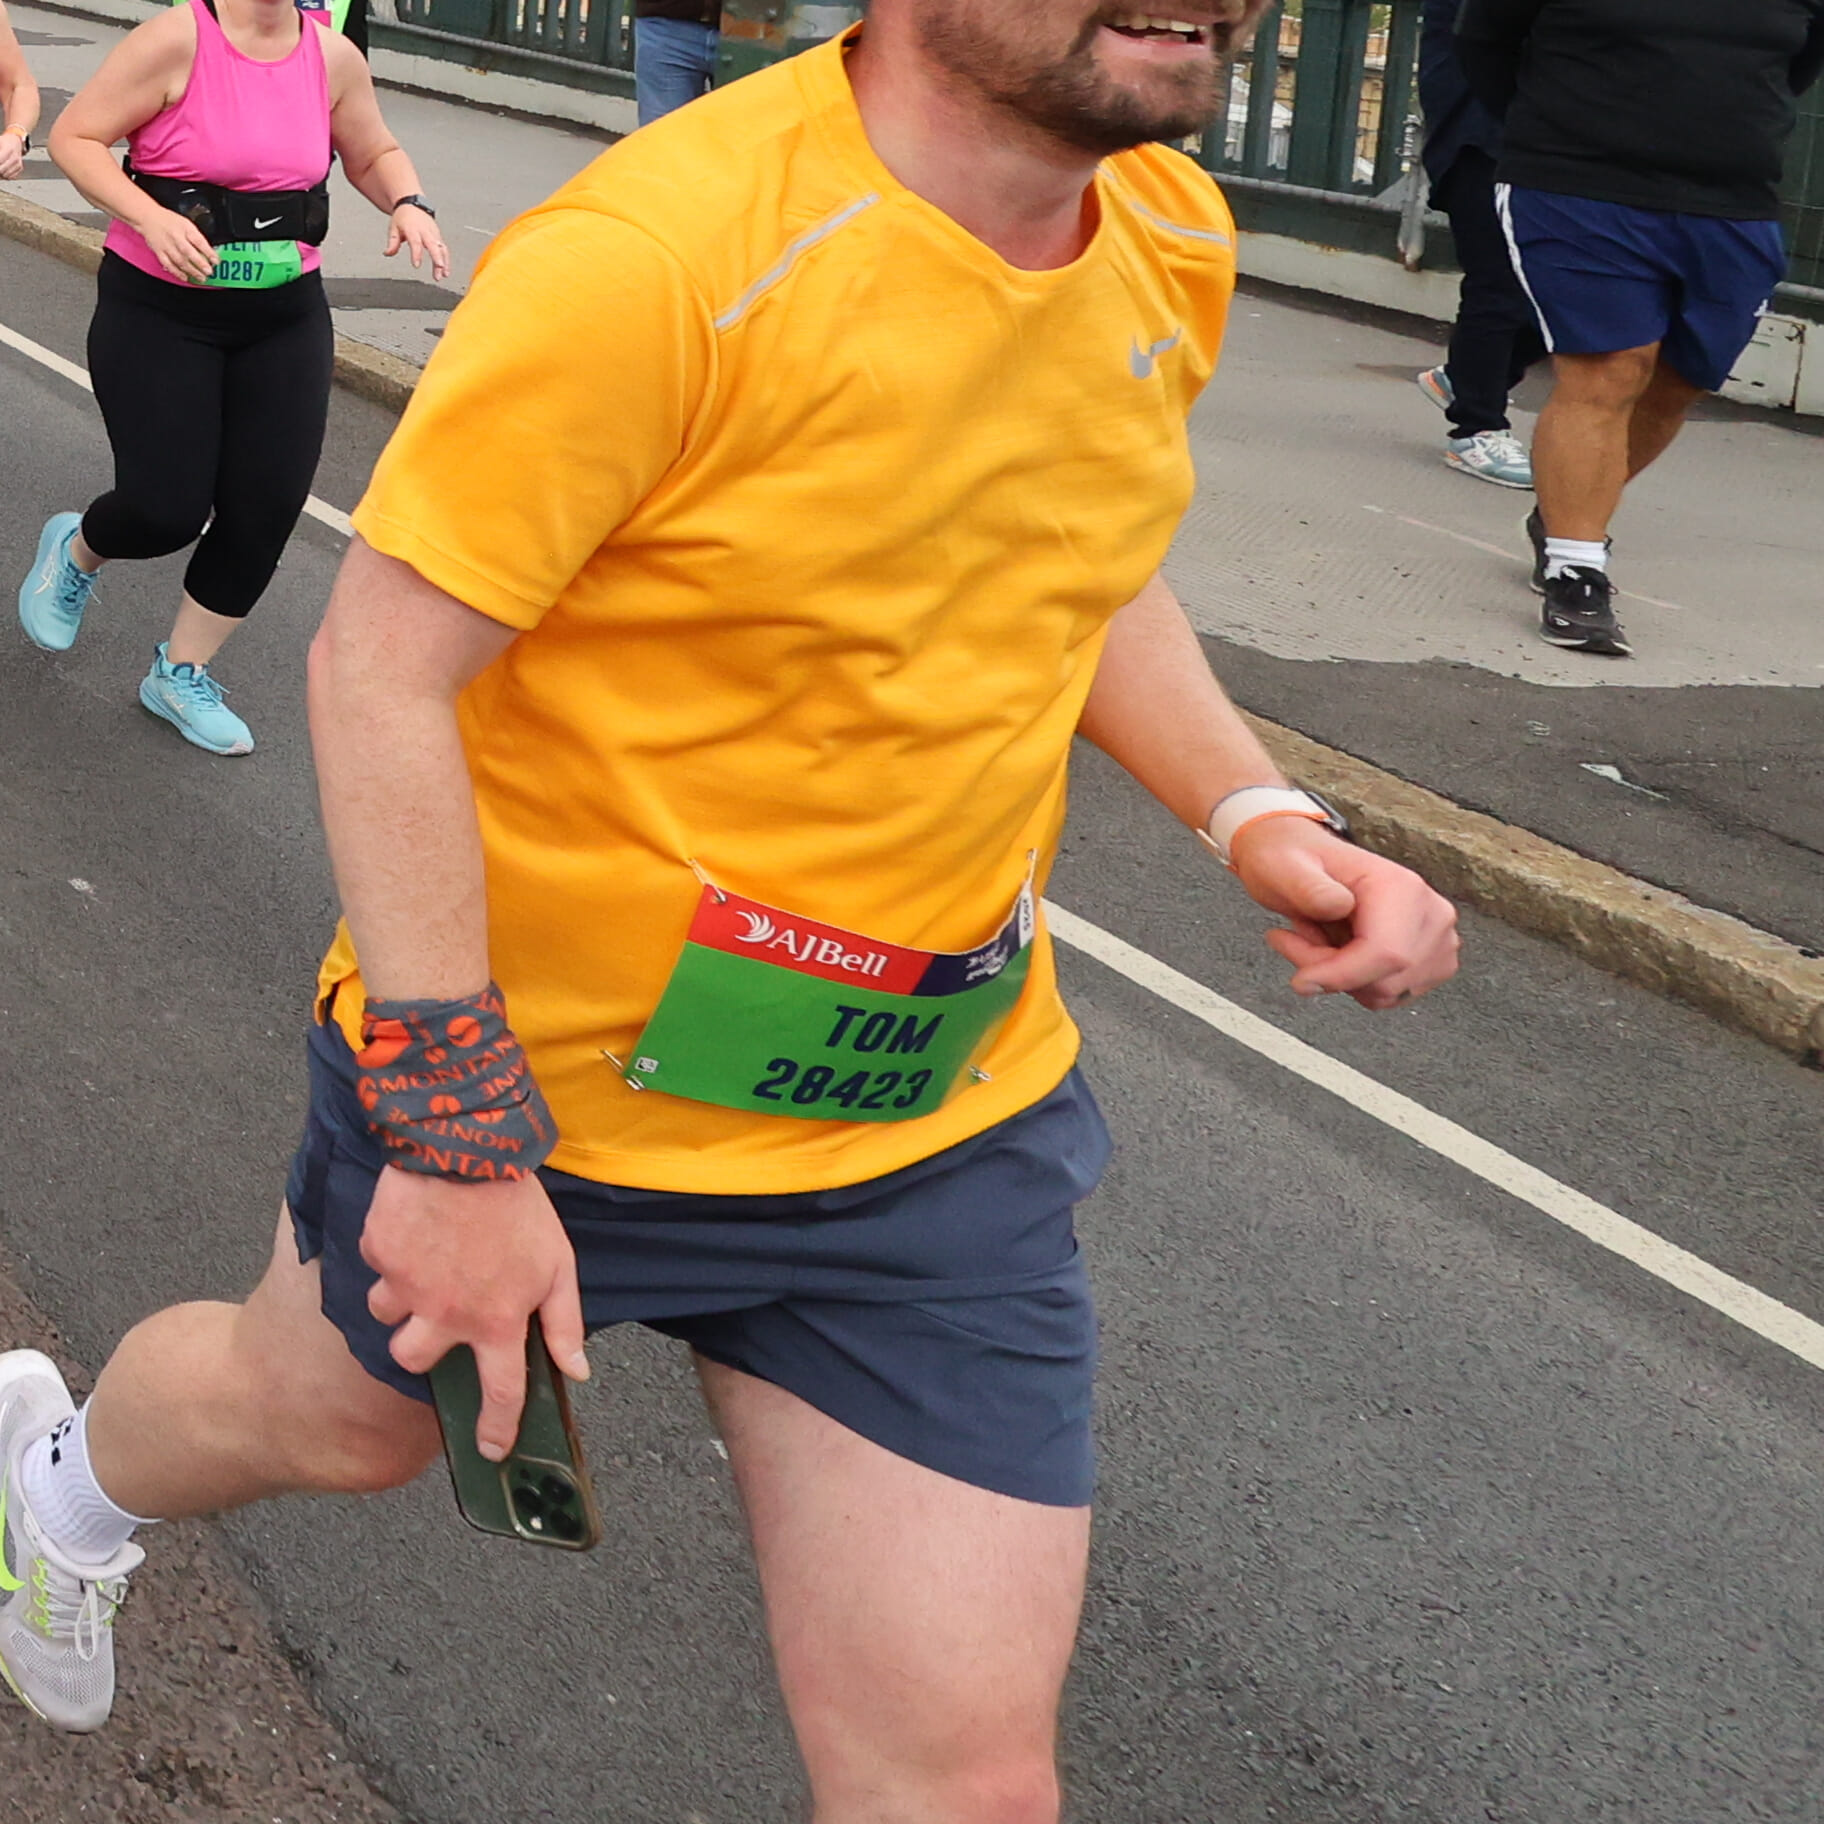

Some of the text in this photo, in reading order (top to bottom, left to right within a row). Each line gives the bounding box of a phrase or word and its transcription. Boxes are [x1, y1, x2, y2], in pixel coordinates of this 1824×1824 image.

[768, 929, 888, 977] AJBell
[825, 1005, 945, 1054] TOM
[380, 1039, 516, 1094] MONTAN
[754, 1058, 933, 1110] 28423
